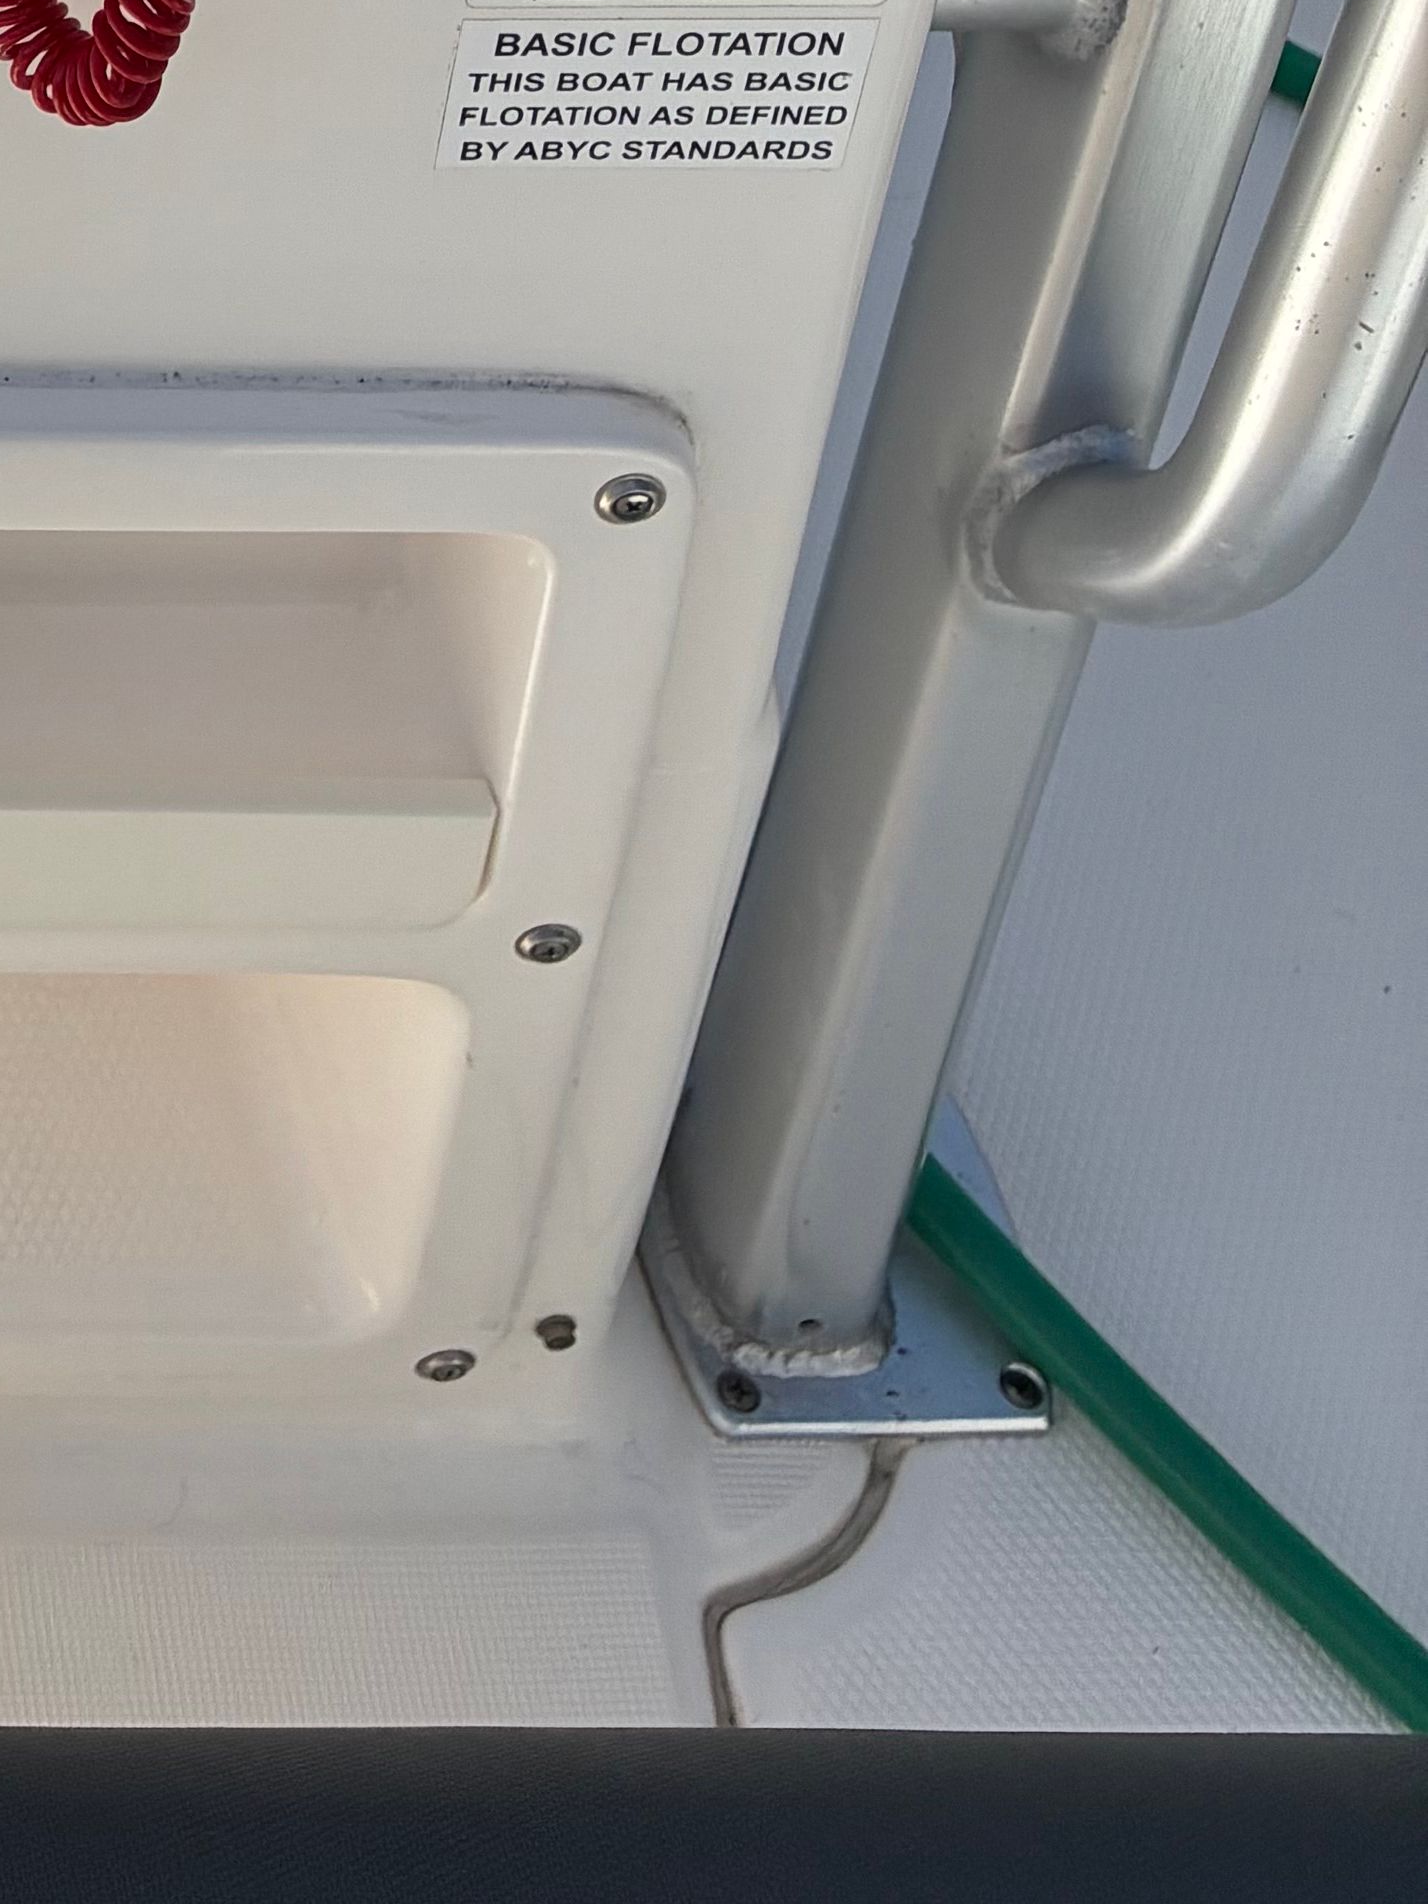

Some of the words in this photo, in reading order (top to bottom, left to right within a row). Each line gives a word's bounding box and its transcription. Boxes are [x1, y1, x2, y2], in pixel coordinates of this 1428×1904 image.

[494, 32, 616, 56] BASIC
[627, 32, 846, 56] FLOTATION
[468, 72, 545, 93] THIS
[556, 72, 654, 92] BOAT
[661, 72, 734, 92] HAS
[744, 72, 853, 92] BASIC
[459, 106, 641, 127] FLOTATION
[648, 106, 695, 126] AS
[705, 105, 848, 126] DEFINED
[459, 141, 509, 161] BY
[513, 141, 613, 161] ABYC
[622, 140, 833, 160] STANDARDS
